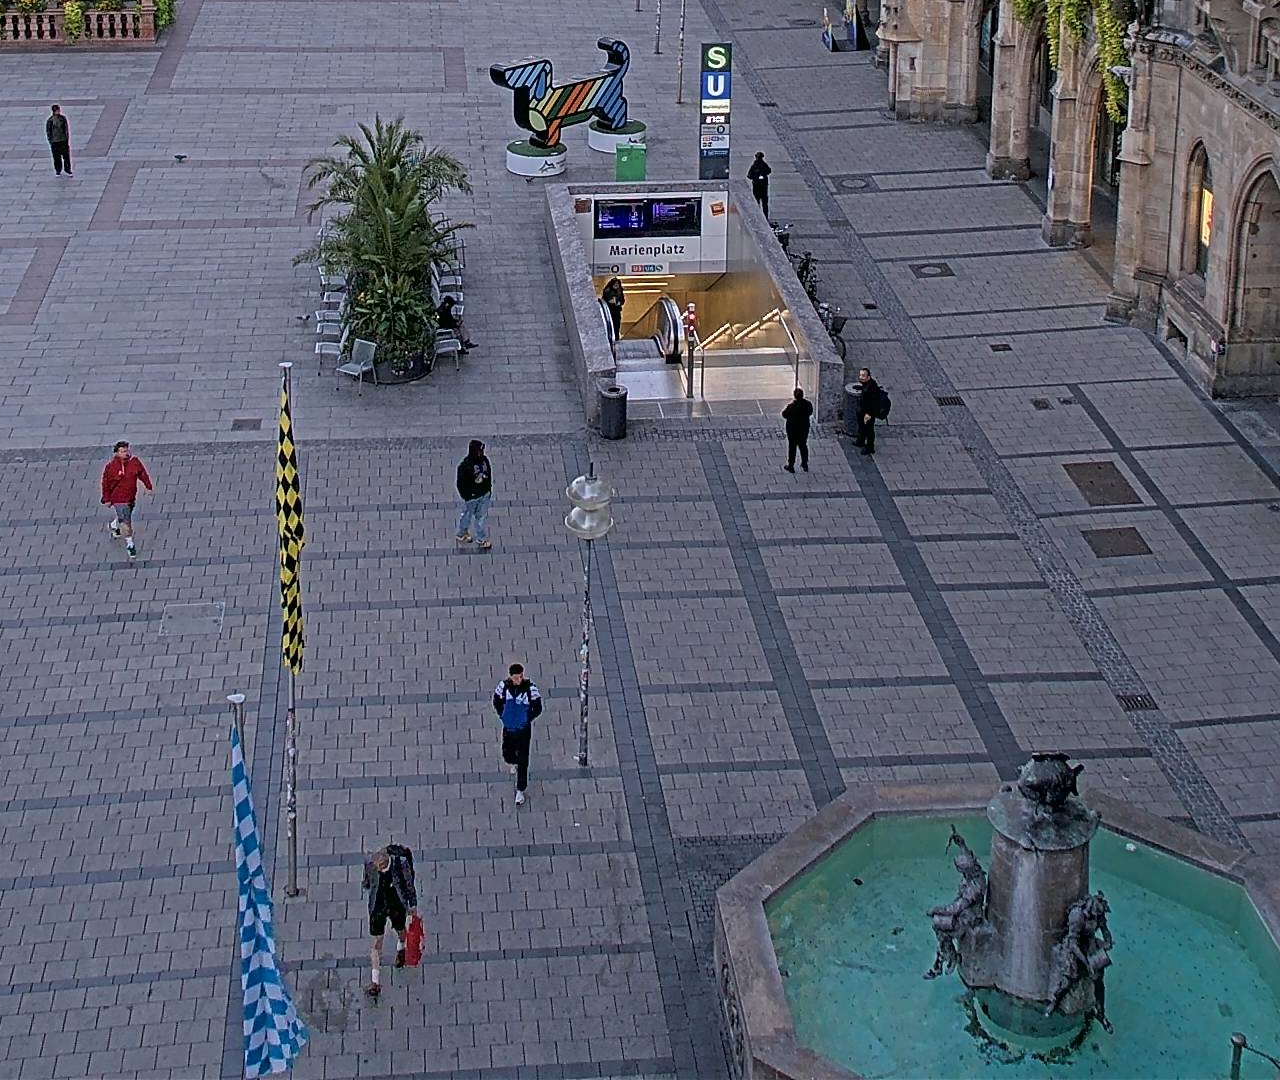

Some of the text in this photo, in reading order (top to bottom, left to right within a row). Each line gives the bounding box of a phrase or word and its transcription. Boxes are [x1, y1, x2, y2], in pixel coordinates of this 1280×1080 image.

[707, 46, 727, 69] S
[707, 75, 725, 97] U
[609, 243, 685, 258] Marienplatz
